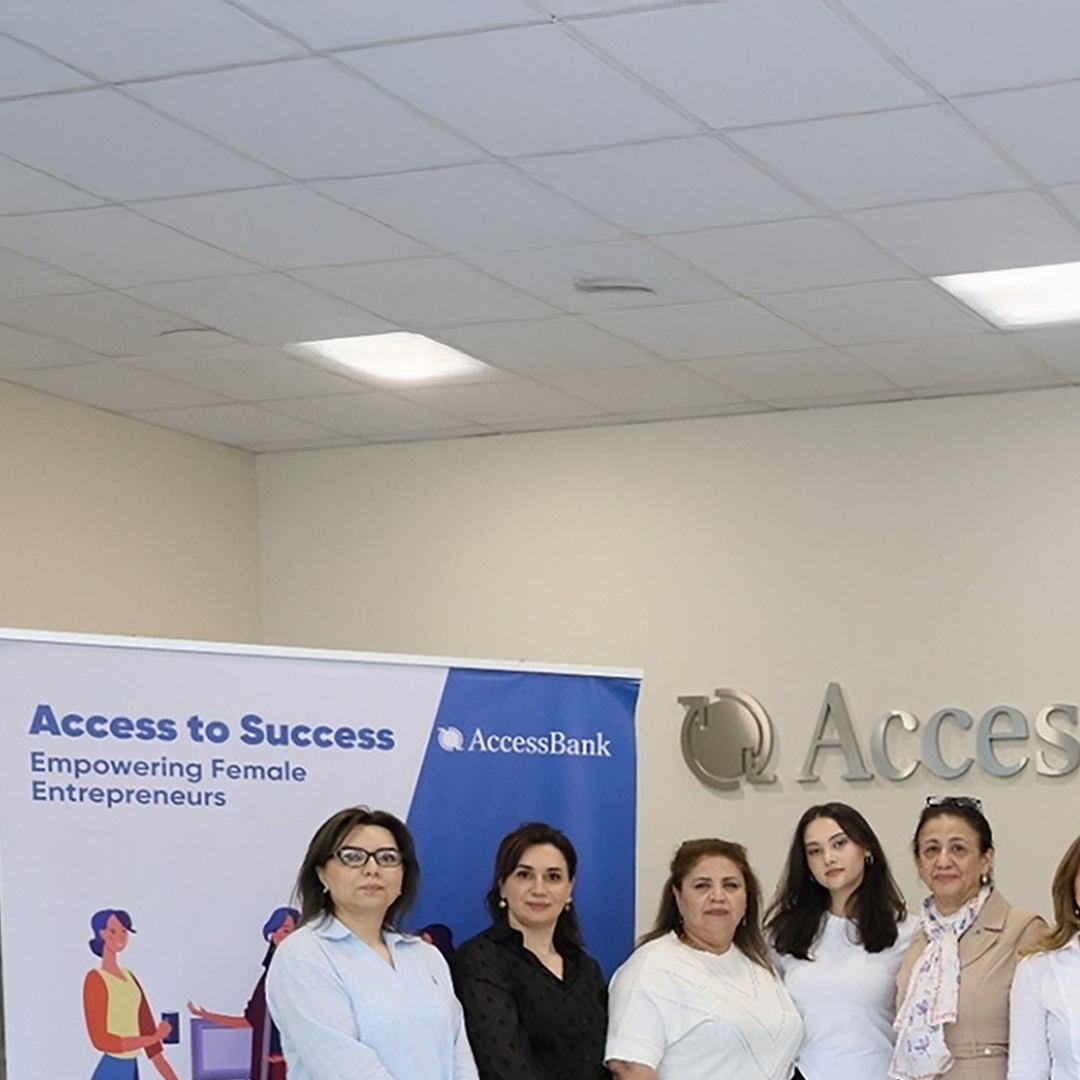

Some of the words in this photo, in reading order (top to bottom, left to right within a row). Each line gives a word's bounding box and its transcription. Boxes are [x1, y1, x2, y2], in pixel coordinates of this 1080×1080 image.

[29, 704, 177, 741] Access
[187, 713, 229, 744] to
[240, 714, 395, 751] Success
[468, 727, 611, 758] AccessBank
[30, 751, 202, 784] Empowering
[211, 758, 307, 782] Female
[31, 780, 227, 808] Entrepreneurs
